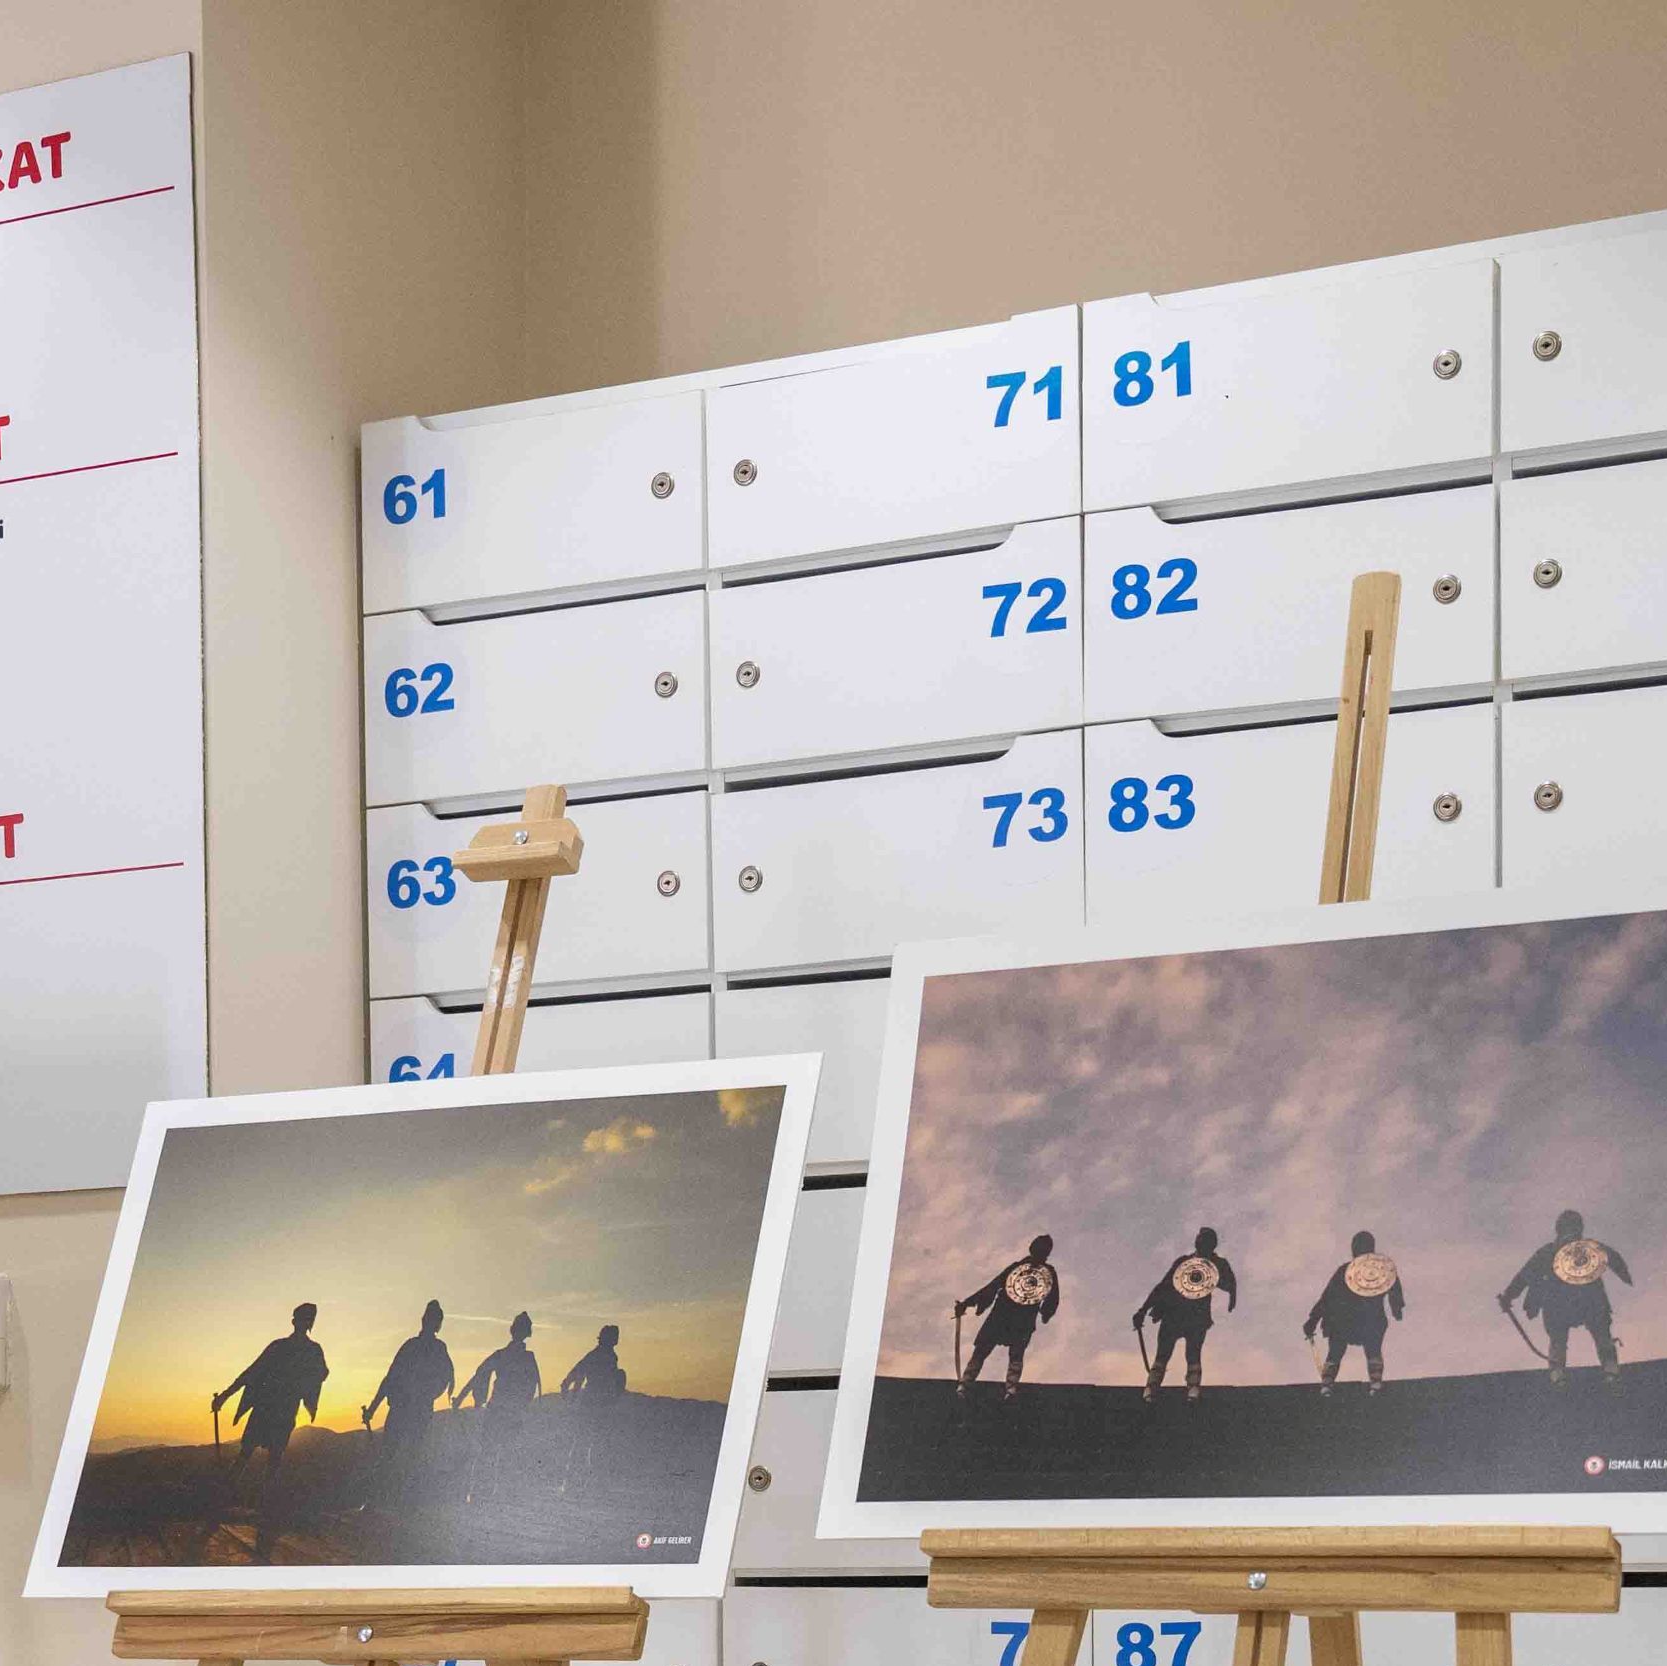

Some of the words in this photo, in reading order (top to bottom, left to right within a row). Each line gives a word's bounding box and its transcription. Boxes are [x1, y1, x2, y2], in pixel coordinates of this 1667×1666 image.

[986, 366, 1063, 427] 71
[1112, 341, 1193, 407] 81
[383, 468, 447, 525] 61
[982, 577, 1067, 638] 72
[1110, 557, 1198, 620] 82
[384, 662, 455, 718] 62
[983, 786, 1068, 847] 73
[1108, 774, 1196, 833] 83
[387, 856, 456, 909] 63
